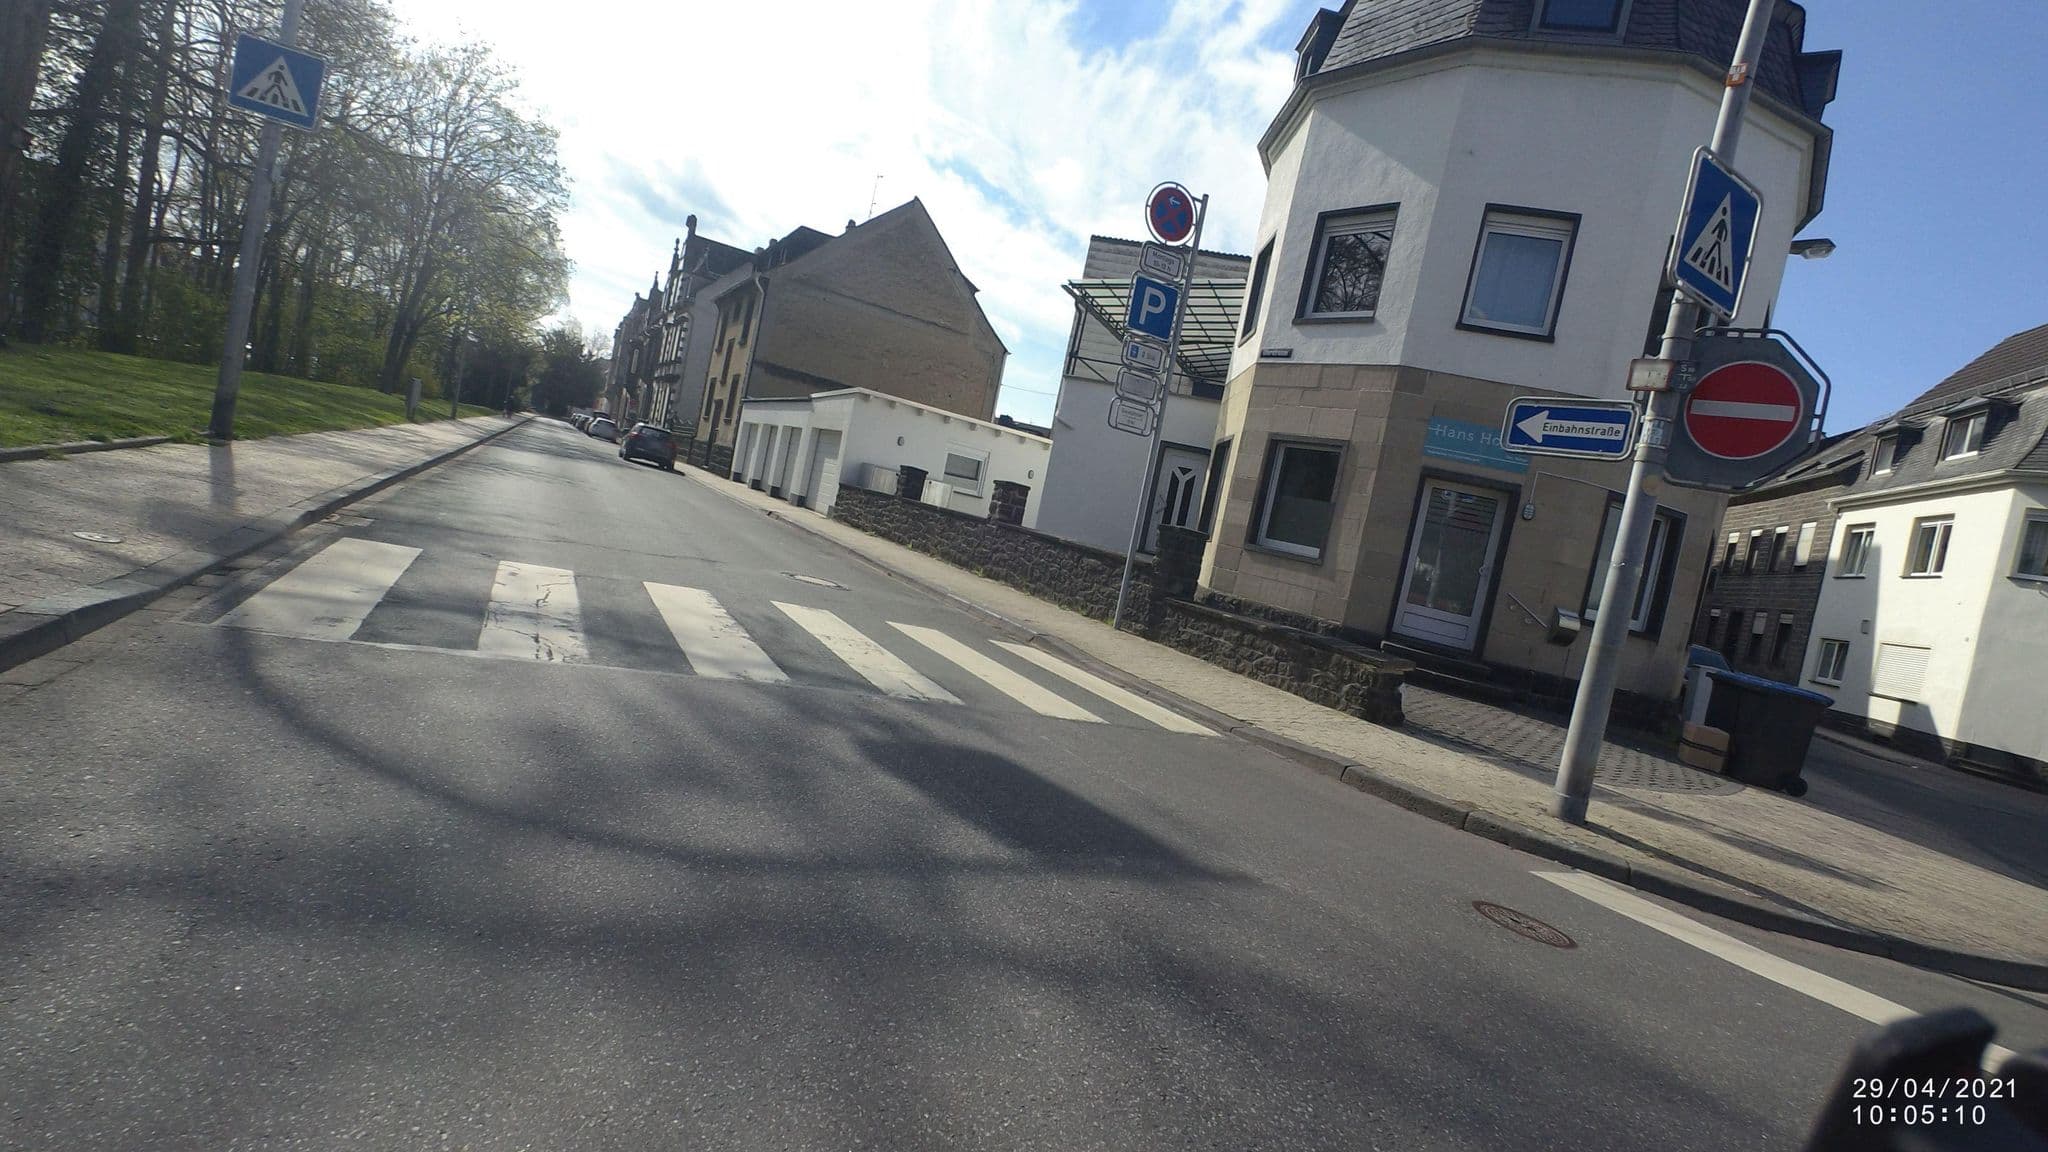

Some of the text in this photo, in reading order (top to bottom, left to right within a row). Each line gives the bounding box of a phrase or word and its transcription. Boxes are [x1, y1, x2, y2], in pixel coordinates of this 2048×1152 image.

[1139, 286, 1166, 325] P
[1429, 424, 1501, 446] Hans Ho
[1542, 422, 1621, 437] Einbahnstraße
